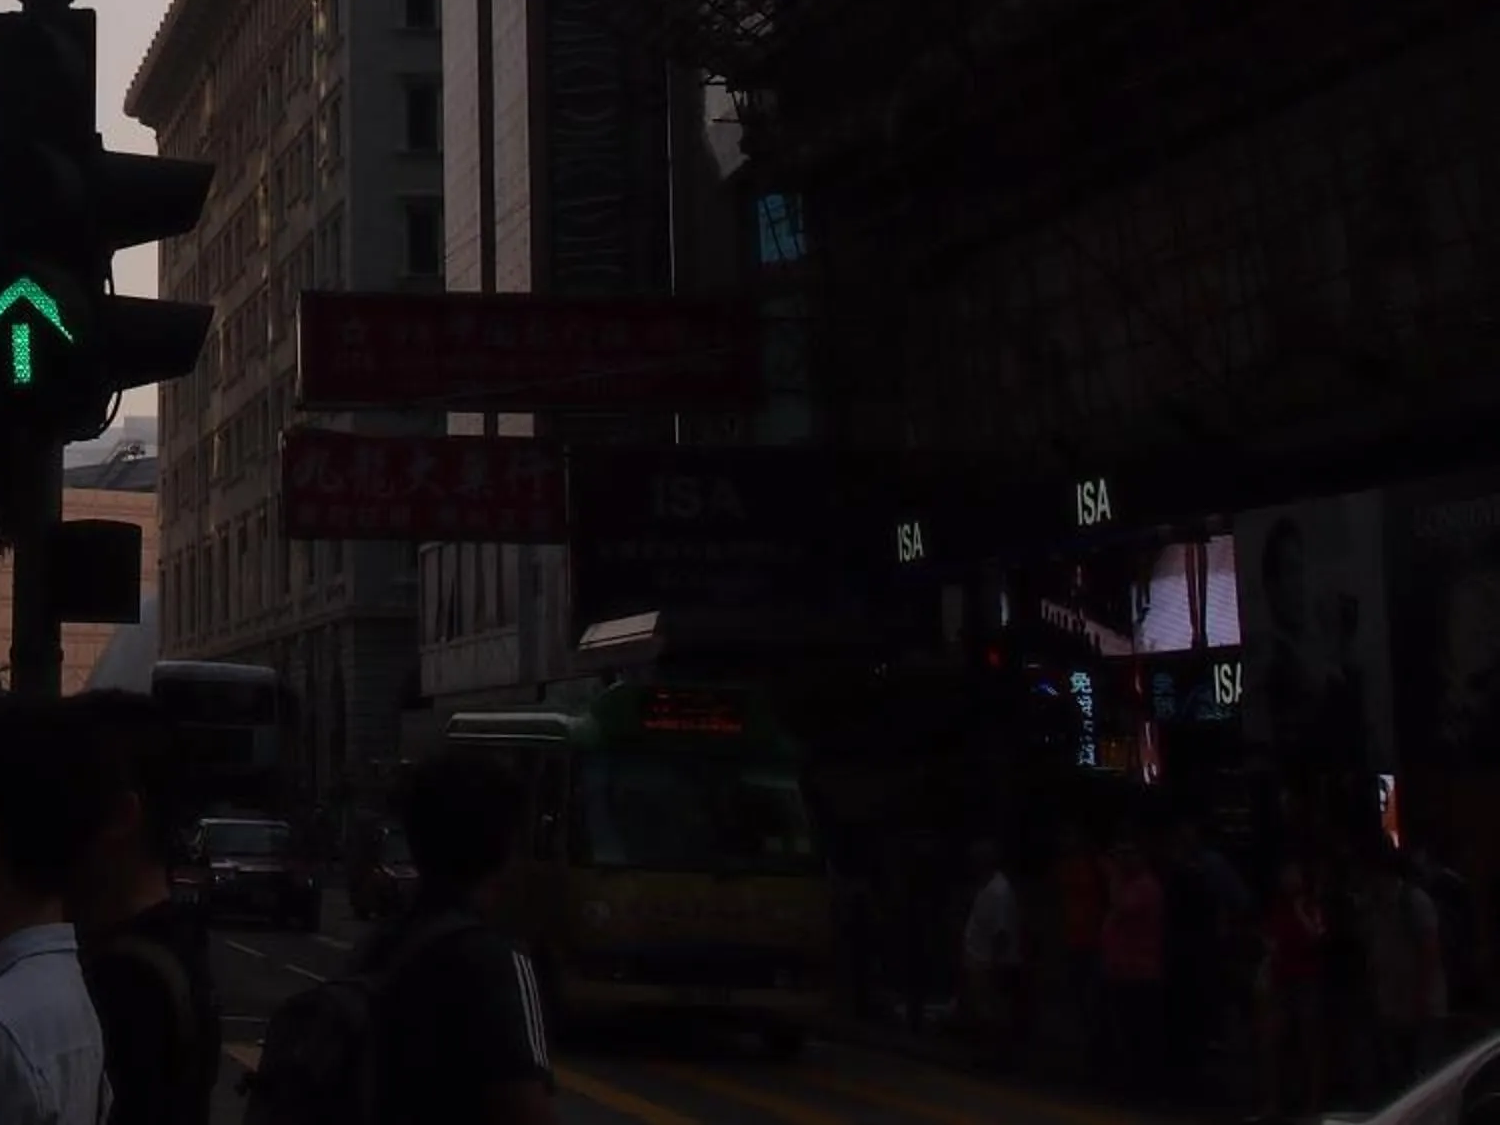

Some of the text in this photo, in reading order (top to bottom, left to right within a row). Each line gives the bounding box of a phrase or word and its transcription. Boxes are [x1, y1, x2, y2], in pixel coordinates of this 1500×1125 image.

[649, 474, 749, 521] ISA
[1076, 477, 1112, 526] ISA
[897, 523, 925, 563] ISA
